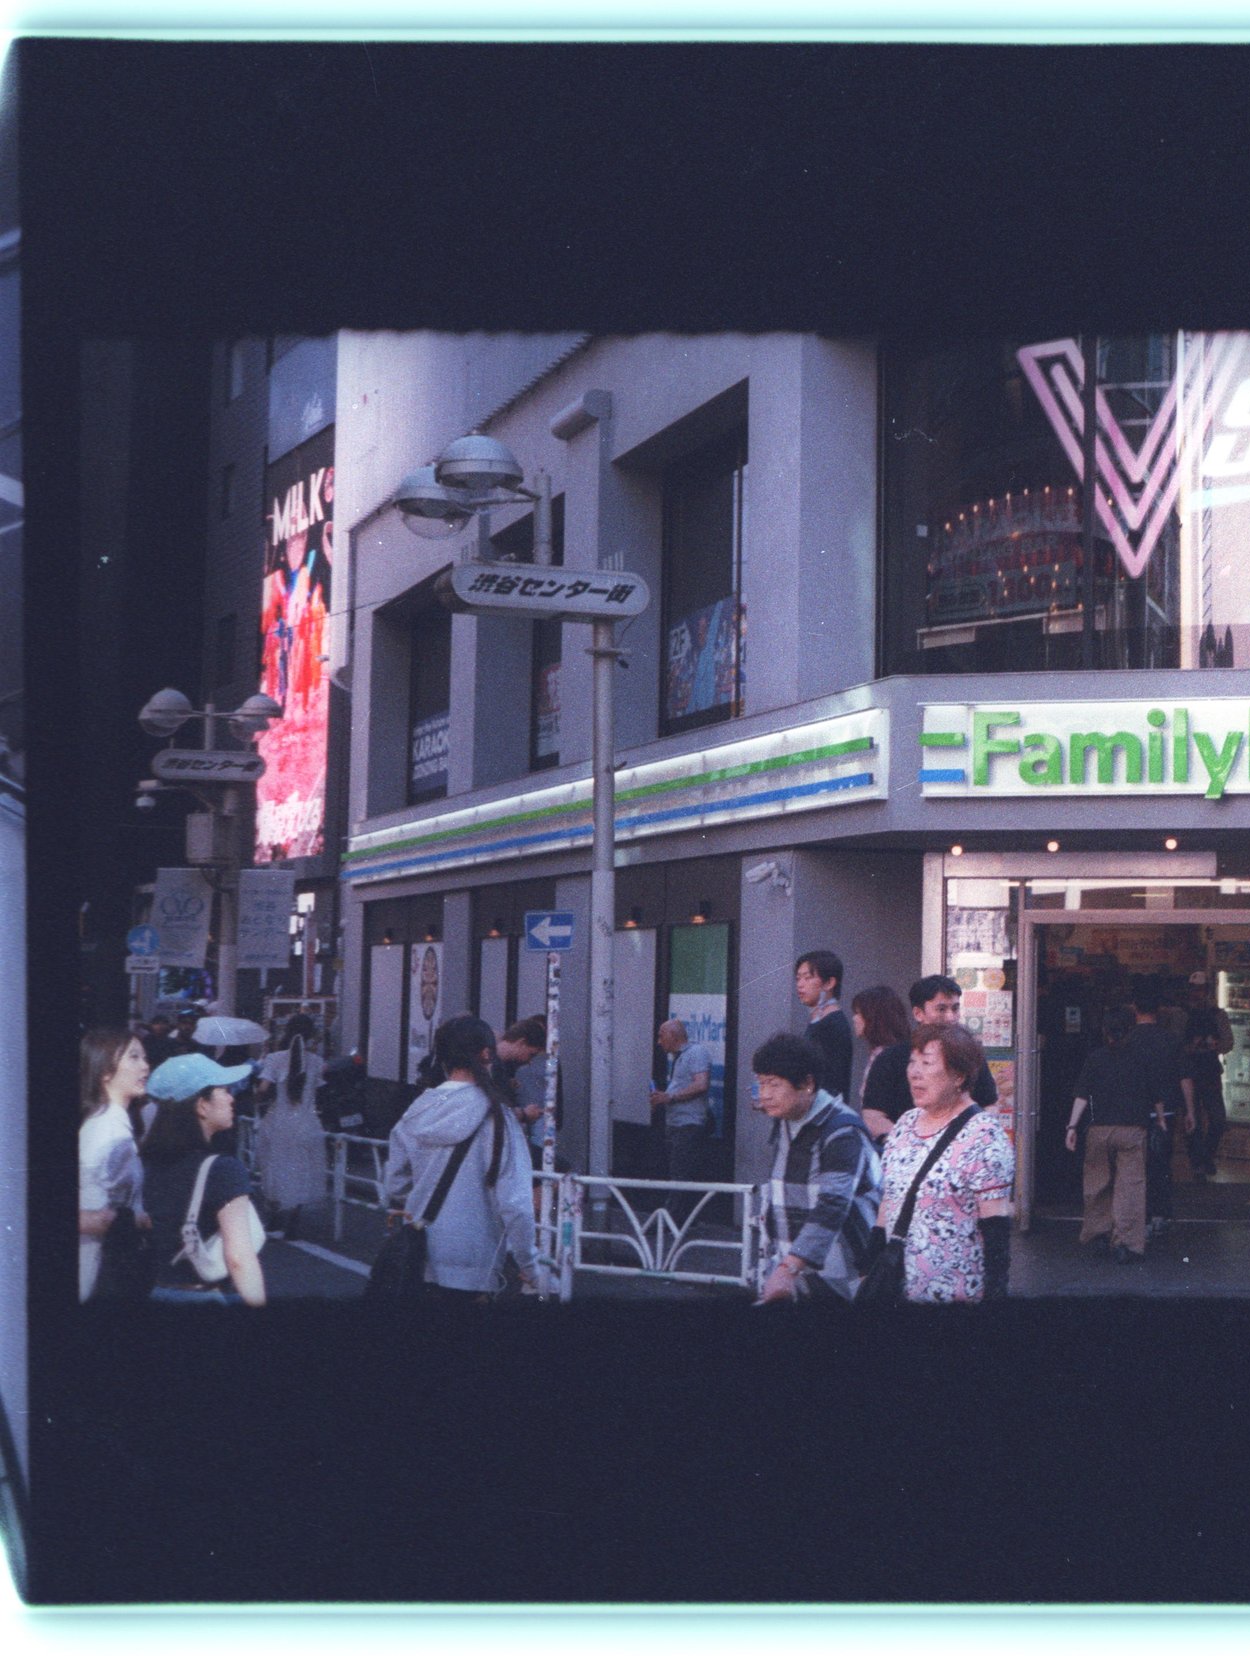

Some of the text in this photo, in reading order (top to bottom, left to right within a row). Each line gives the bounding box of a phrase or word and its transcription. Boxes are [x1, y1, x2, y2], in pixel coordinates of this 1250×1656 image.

[467, 572, 637, 604] 渋谷センター街
